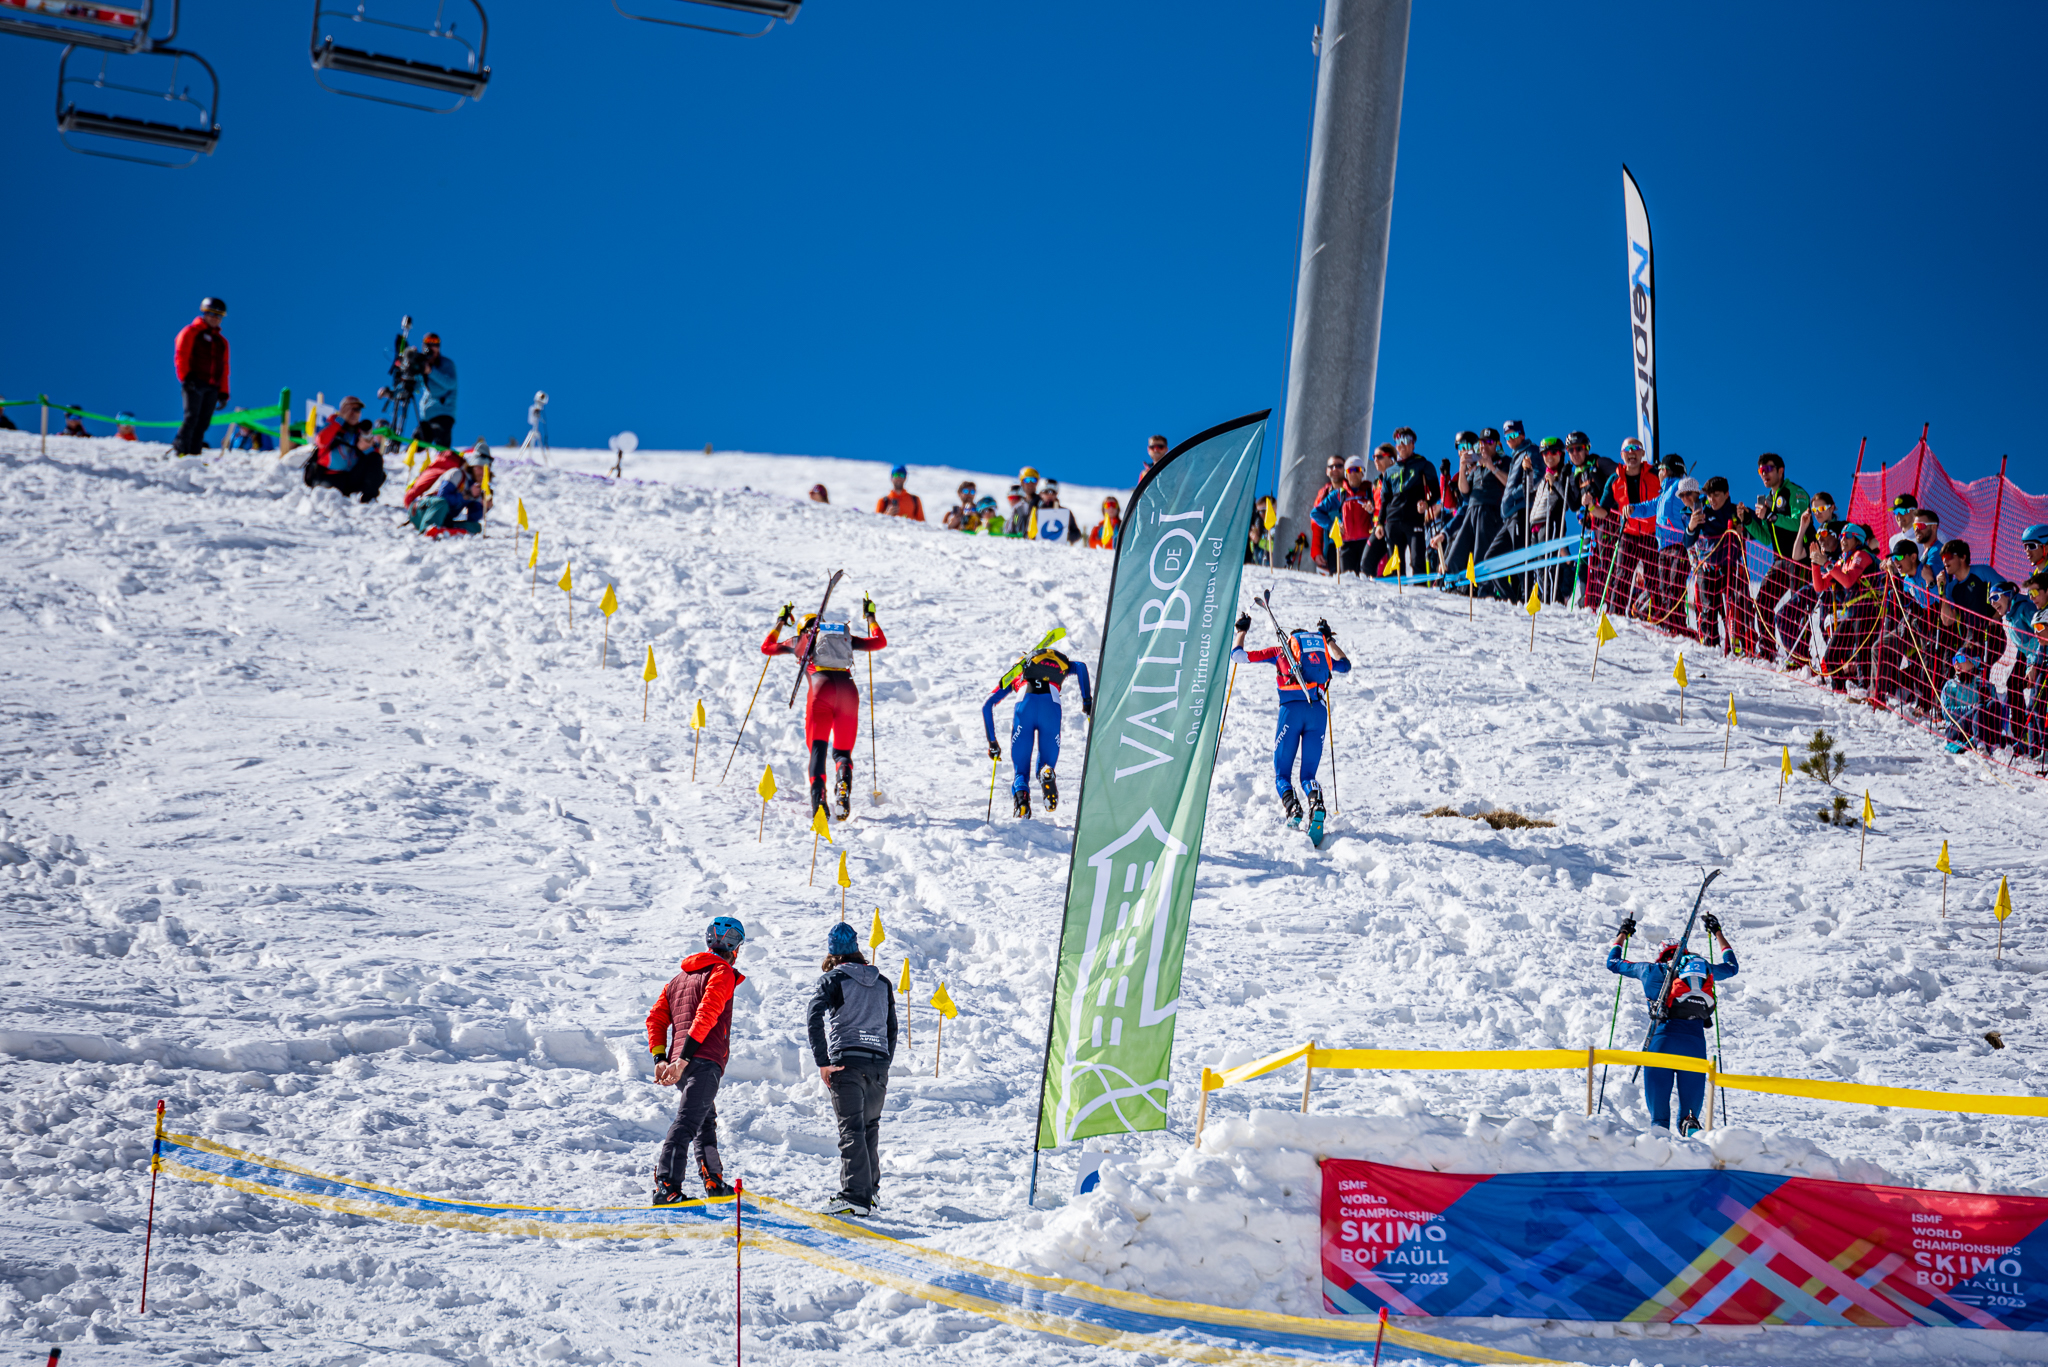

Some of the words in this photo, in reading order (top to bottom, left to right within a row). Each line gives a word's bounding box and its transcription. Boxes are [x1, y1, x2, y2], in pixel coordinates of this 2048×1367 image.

[1208, 536, 1223, 557] cel
[1164, 547, 1182, 572] DE
[1206, 562, 1218, 574] el
[1201, 577, 1218, 629] toquen
[1306, 639, 1321, 647] 5.2
[1191, 633, 1211, 694] Pirineus
[1189, 698, 1204, 716] els
[1185, 720, 1201, 745] On
[1338, 1179, 1368, 1191] ISMF
[1340, 1194, 1388, 1205] WORLD
[1340, 1207, 1446, 1221] CHAMPIONSHIPS
[1911, 1213, 1943, 1224] ISMF
[1340, 1220, 1447, 1244] SKIMO
[1912, 1226, 1962, 1239] WORLD
[1340, 1246, 1377, 1263] BOÍ
[1383, 1246, 1449, 1266] TAÜLL
[1912, 1239, 2022, 1256] CHAMPIONSHIPS
[1914, 1251, 2022, 1277] SKIMO
[1409, 1271, 1449, 1285] 2023
[1959, 1278, 2024, 1296] TAÜLL
[1987, 1295, 2027, 1308] 2023
